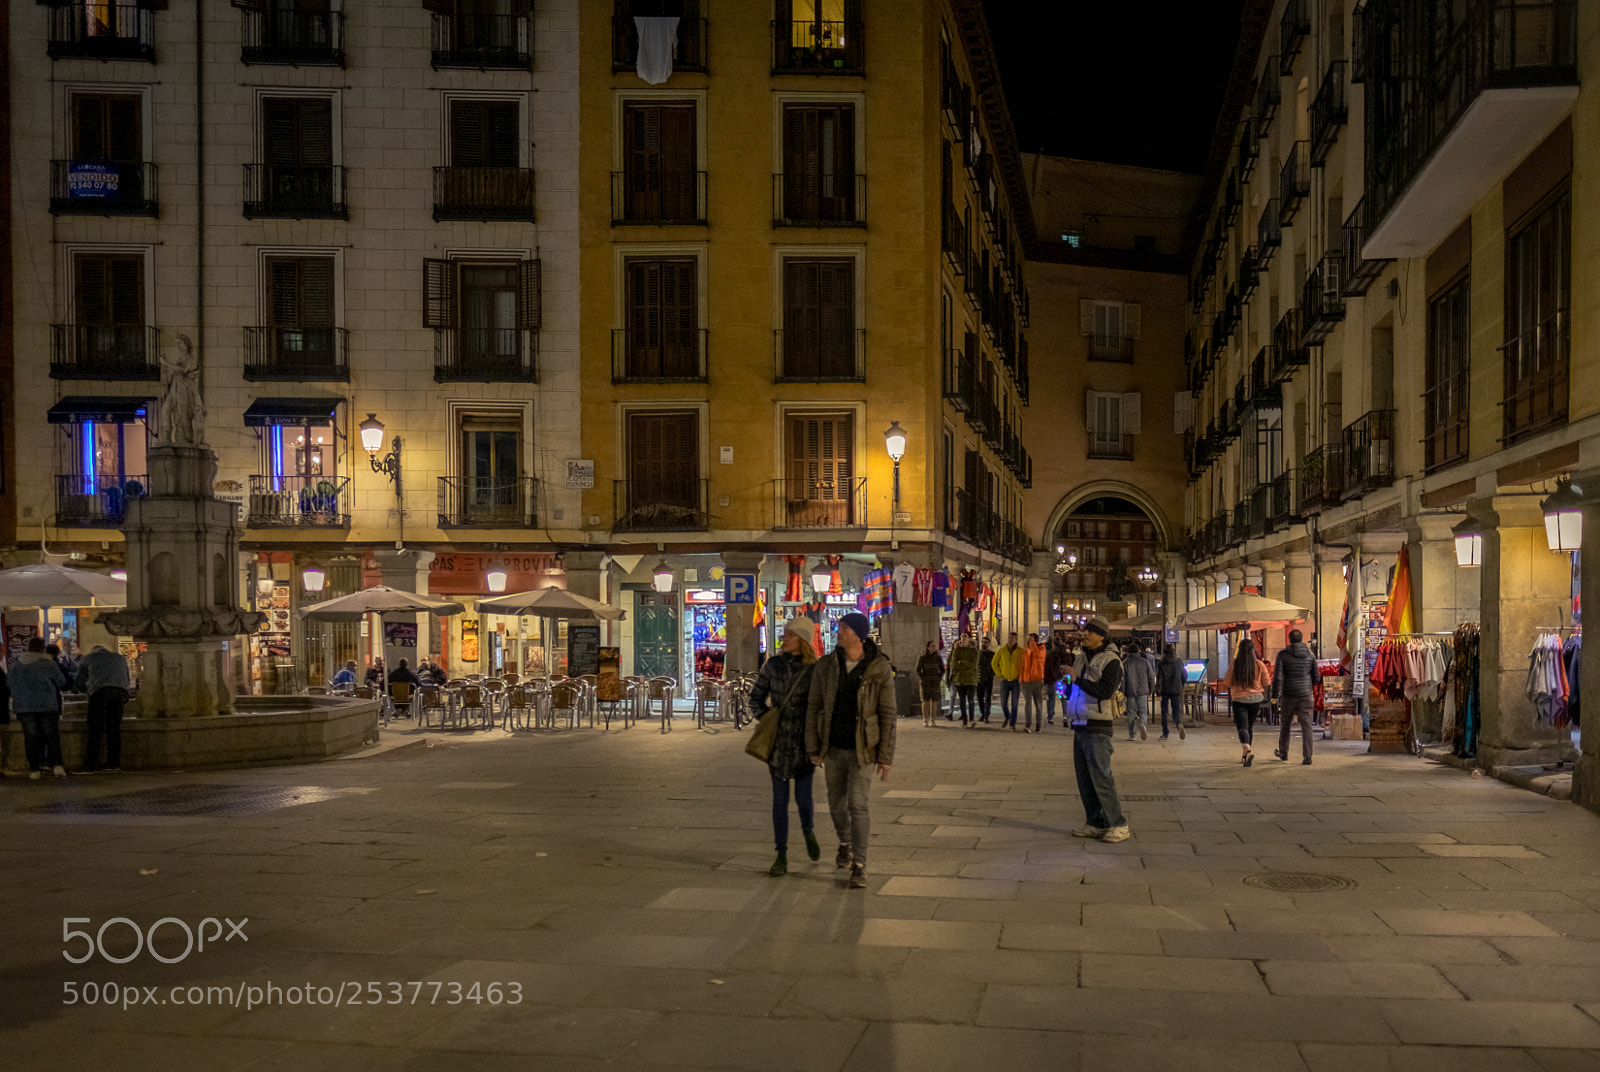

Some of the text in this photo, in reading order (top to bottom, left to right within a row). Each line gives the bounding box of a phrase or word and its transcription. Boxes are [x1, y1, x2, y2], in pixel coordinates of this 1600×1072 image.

[70, 173, 116, 182] VENDIDO
[78, 181, 92, 189] 540
[93, 181, 105, 189] 07
[106, 182, 118, 191] 80
[902, 575, 908, 586] 7
[729, 577, 749, 601] P
